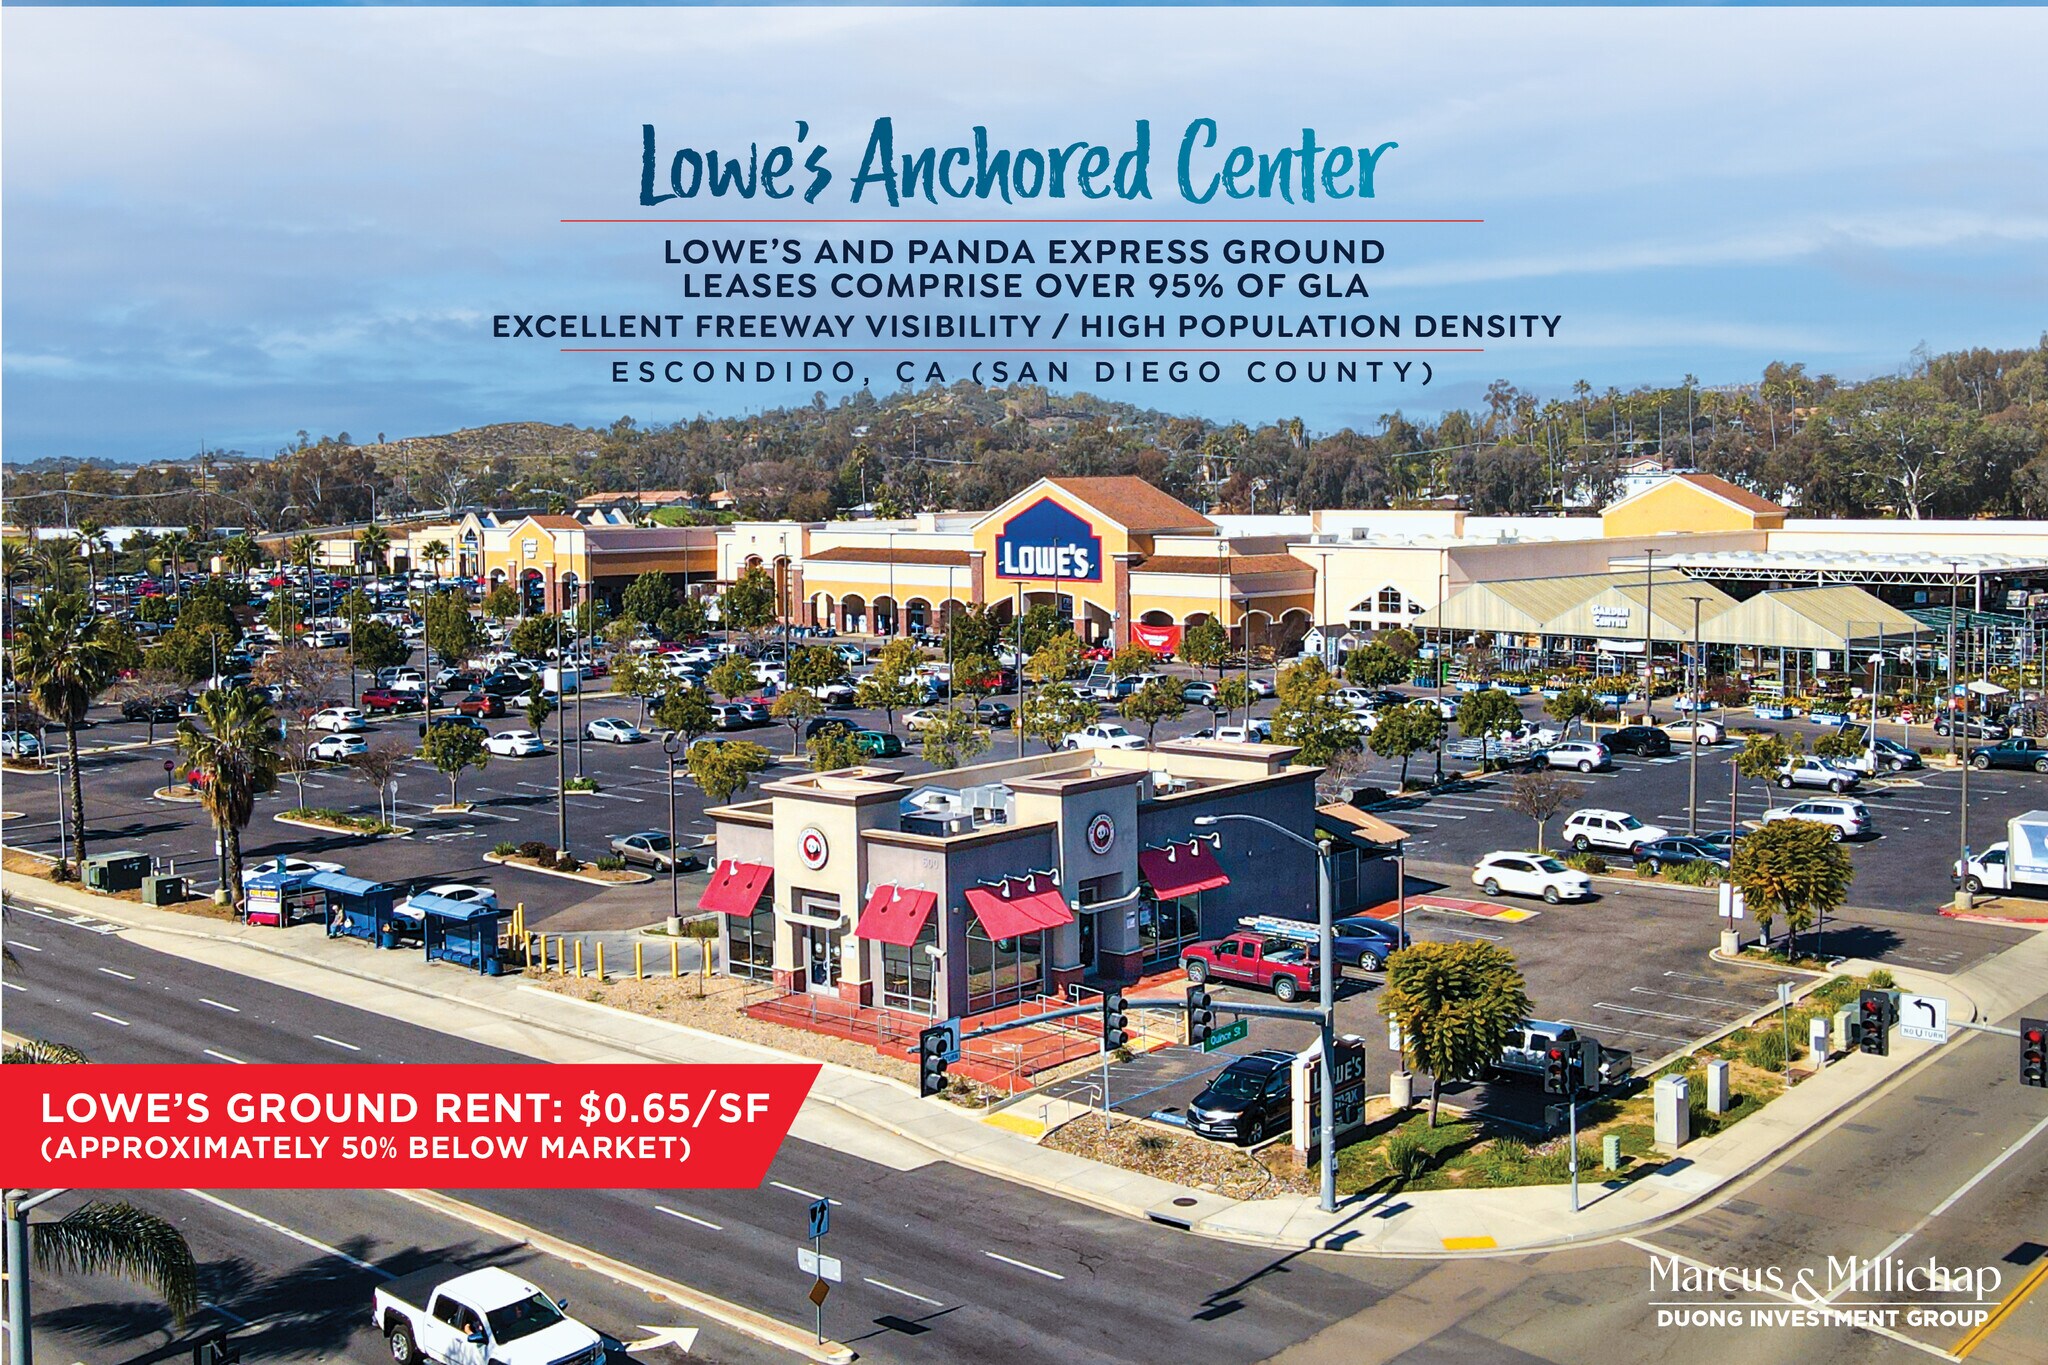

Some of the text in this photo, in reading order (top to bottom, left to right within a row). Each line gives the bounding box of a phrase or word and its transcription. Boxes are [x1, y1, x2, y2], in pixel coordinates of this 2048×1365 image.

[1004, 541, 1089, 578] LOWE'S
[1591, 604, 1630, 617] GARDEN
[1210, 1031, 1231, 1045] Quince
[1924, 1031, 1944, 1039] TURN
[1313, 1056, 1362, 1094] LWE'S
